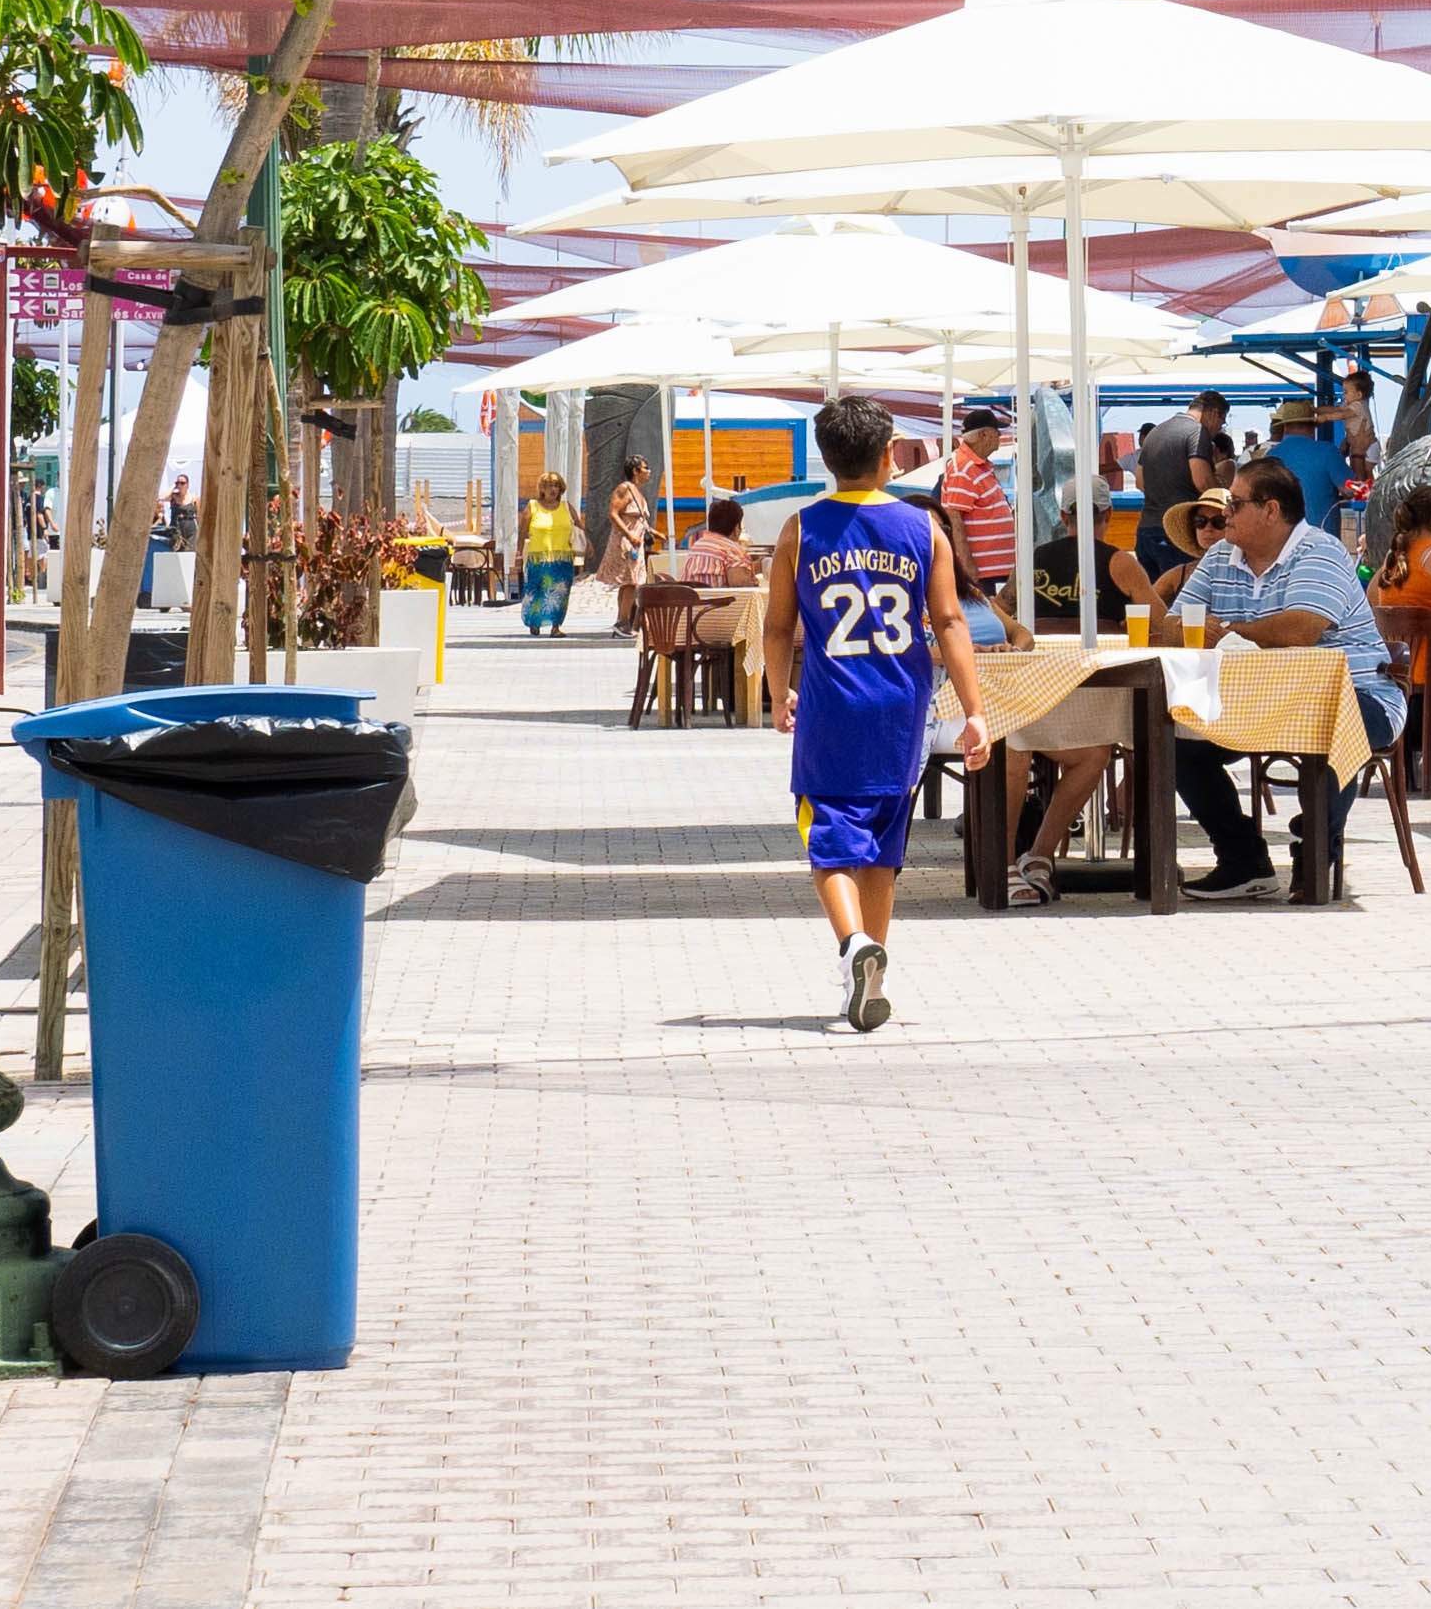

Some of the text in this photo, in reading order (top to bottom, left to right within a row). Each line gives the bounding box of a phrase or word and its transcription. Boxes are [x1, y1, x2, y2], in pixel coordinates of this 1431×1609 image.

[60, 280, 83, 291] Los
[127, 272, 167, 280] Casa de
[809, 549, 918, 584] LOS ANGELES
[820, 583, 913, 658] 23
